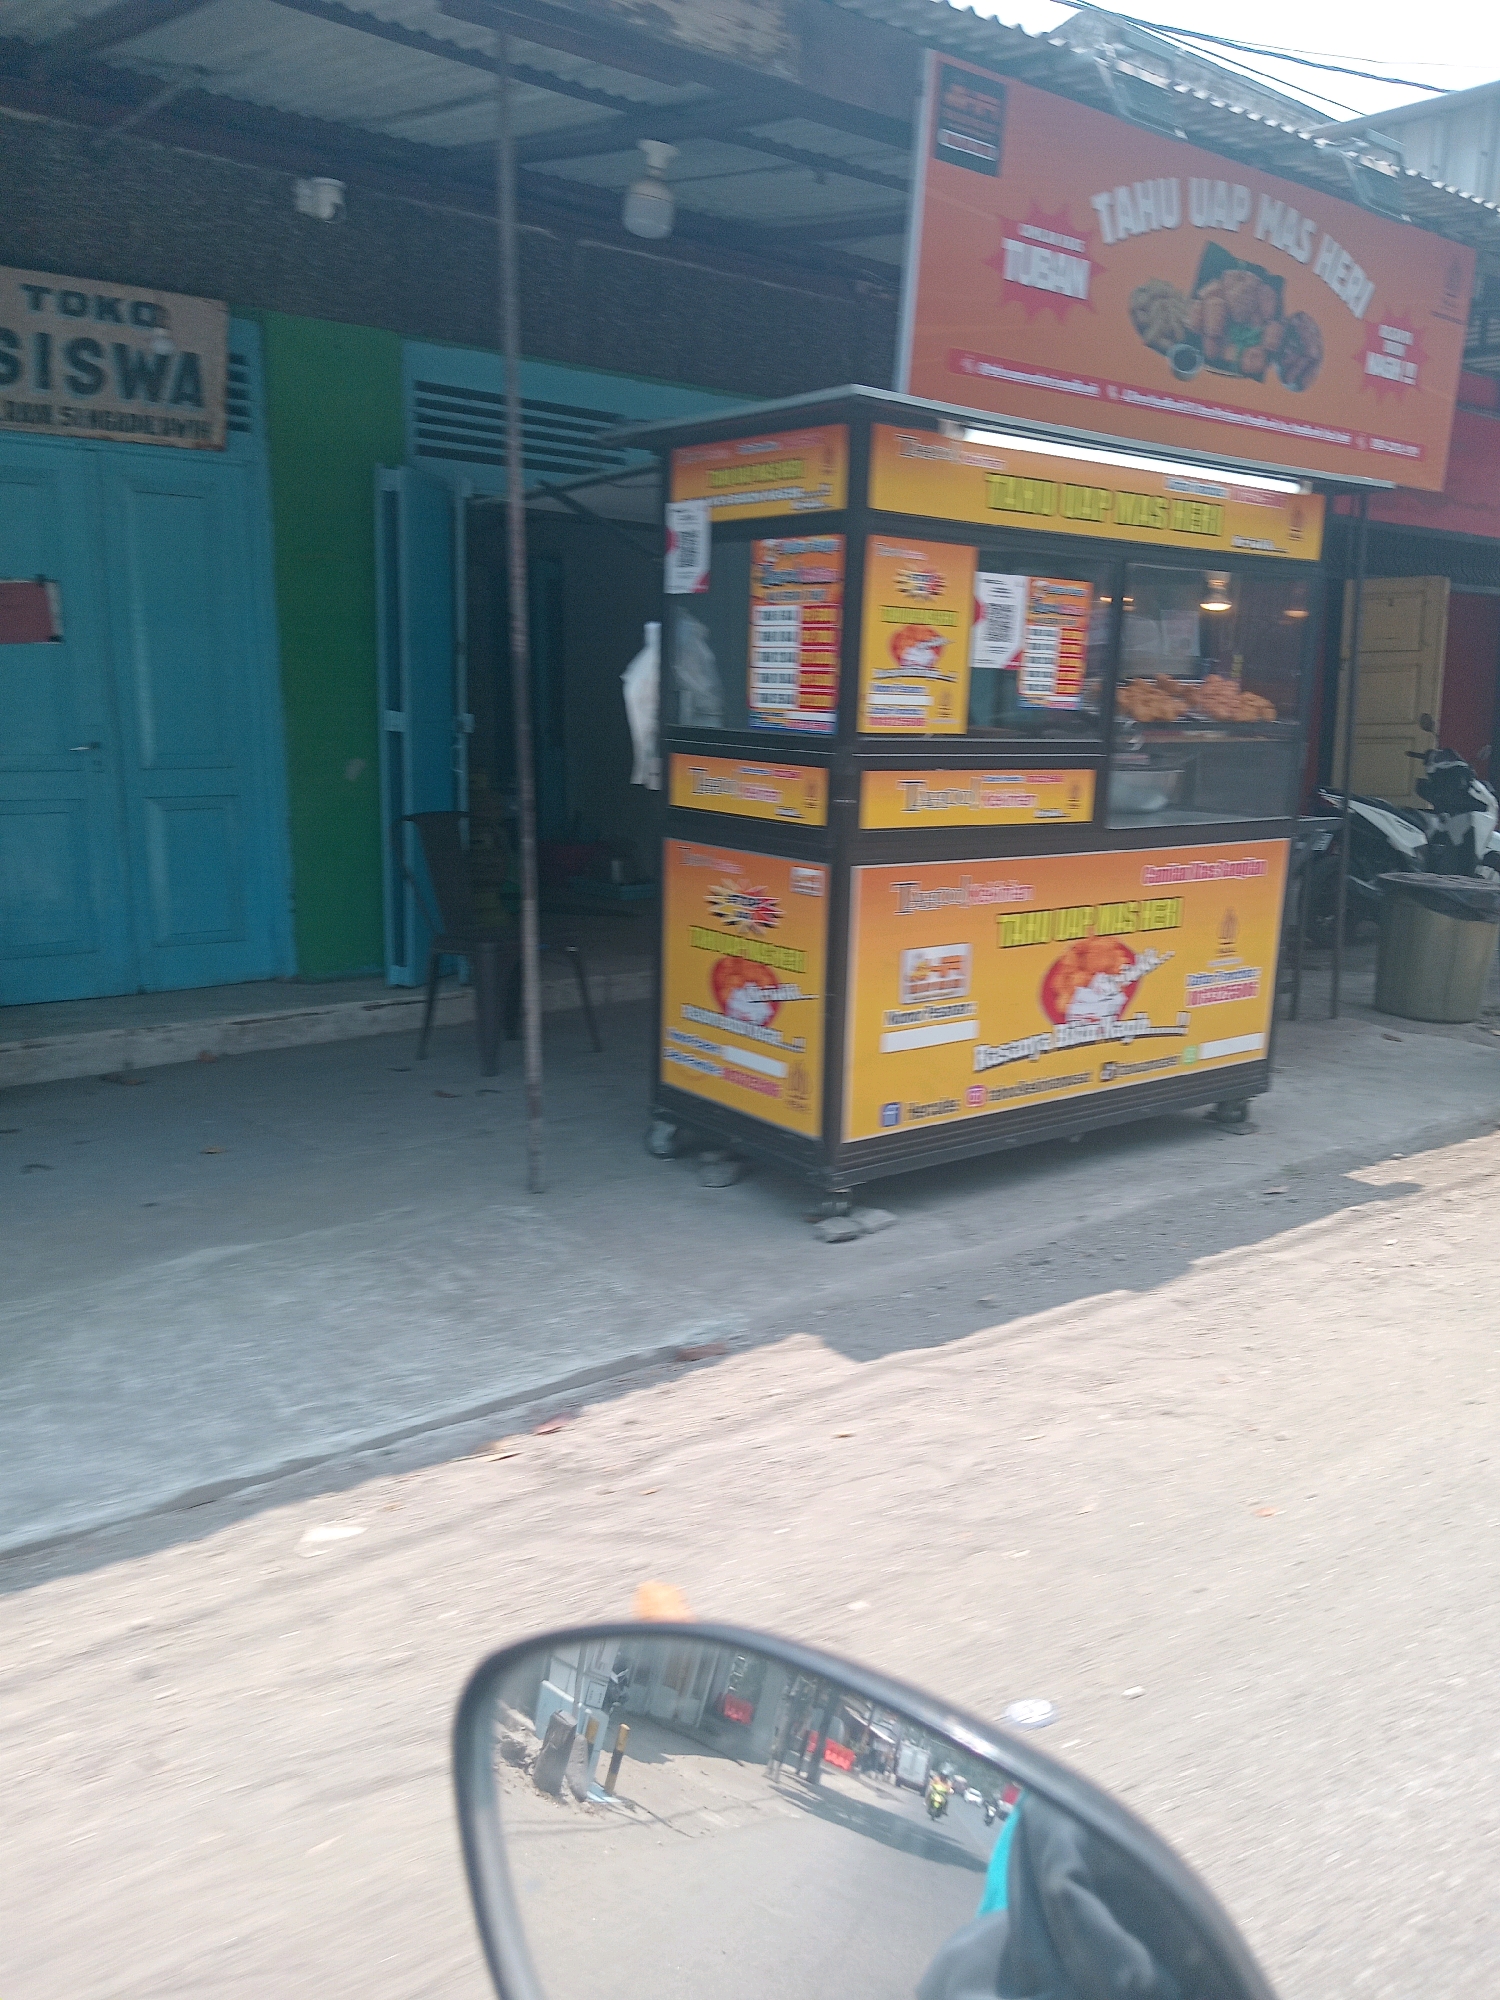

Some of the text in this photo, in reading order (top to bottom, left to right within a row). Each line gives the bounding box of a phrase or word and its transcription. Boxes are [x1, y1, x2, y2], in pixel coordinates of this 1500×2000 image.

[1002, 237, 1091, 301] TUBAN
[1091, 177, 1375, 320] TAHU UAP MAS HERI
[18, 283, 170, 330] TOKO
[985, 471, 1057, 517] TAHU
[1058, 481, 1113, 523] UAP
[1113, 489, 1168, 530] MAS
[1168, 497, 1225, 537] HERI
[996, 895, 1184, 949] TAHU UAP MAS HERI
